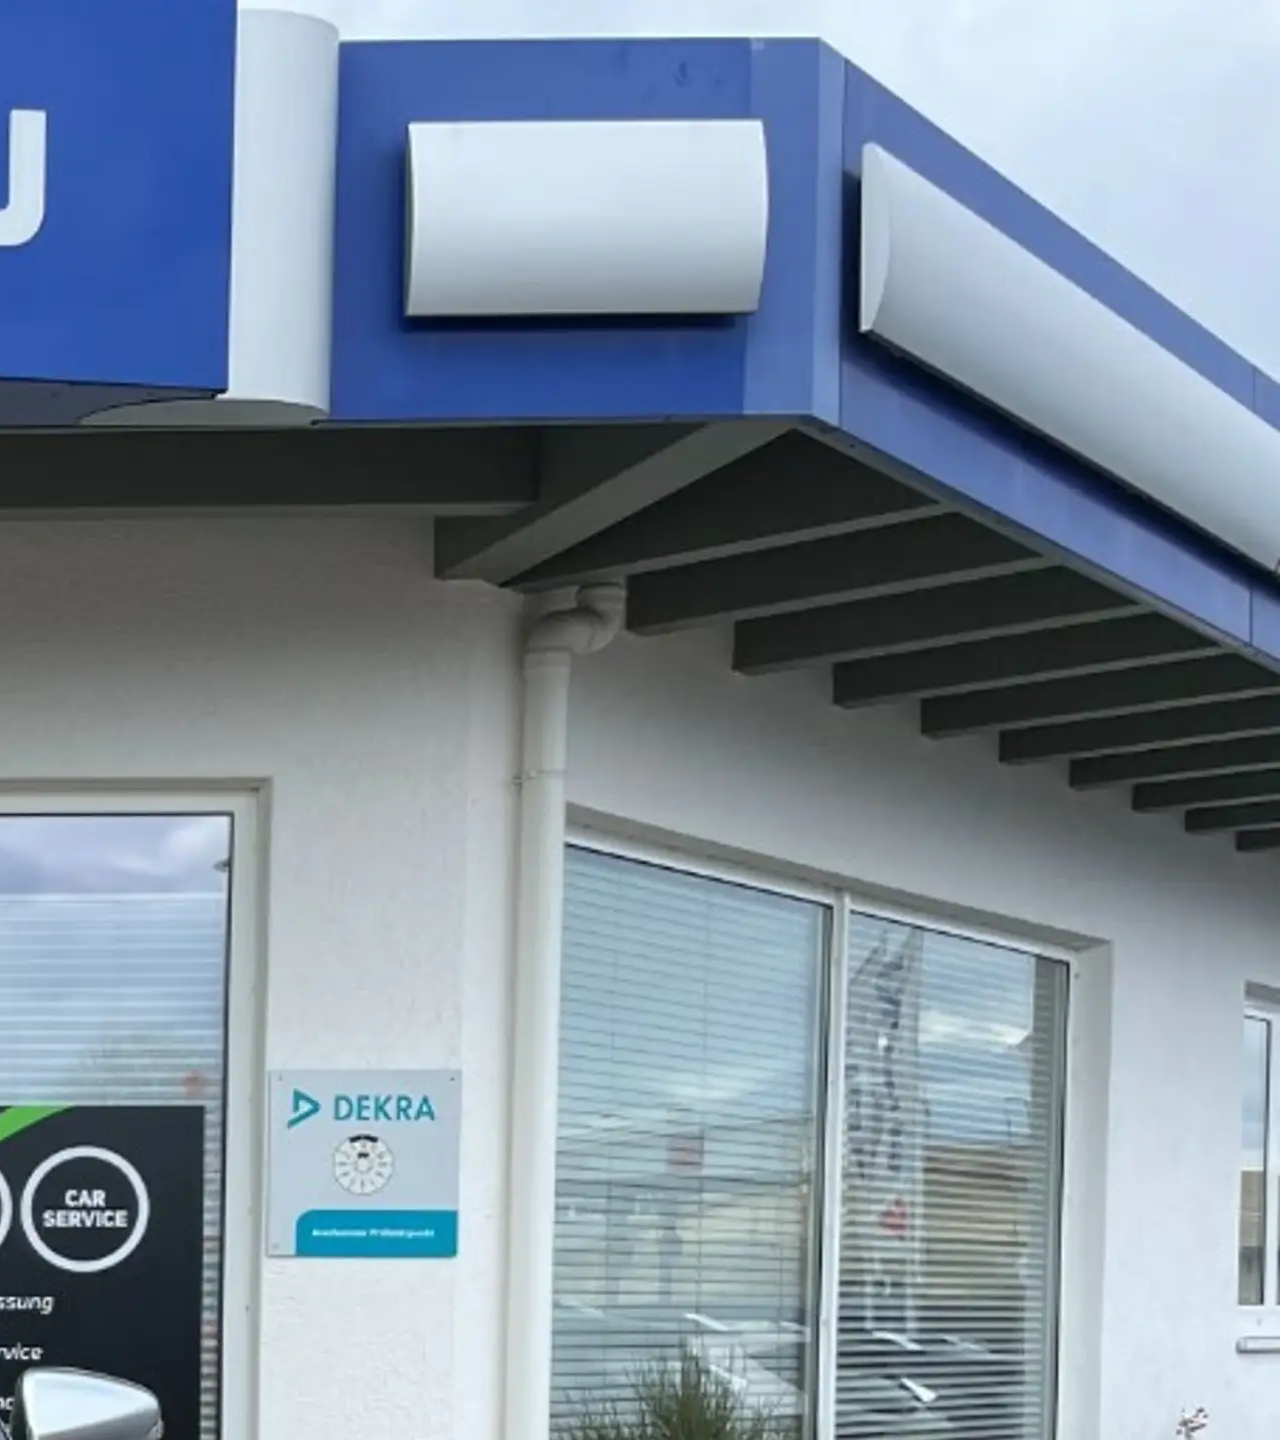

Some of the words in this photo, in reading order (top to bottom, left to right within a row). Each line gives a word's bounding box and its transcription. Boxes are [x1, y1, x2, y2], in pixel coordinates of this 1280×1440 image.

[333, 1094, 435, 1122] DEKRA
[64, 1189, 107, 1208] CAR
[42, 1209, 128, 1229] SERVICE
